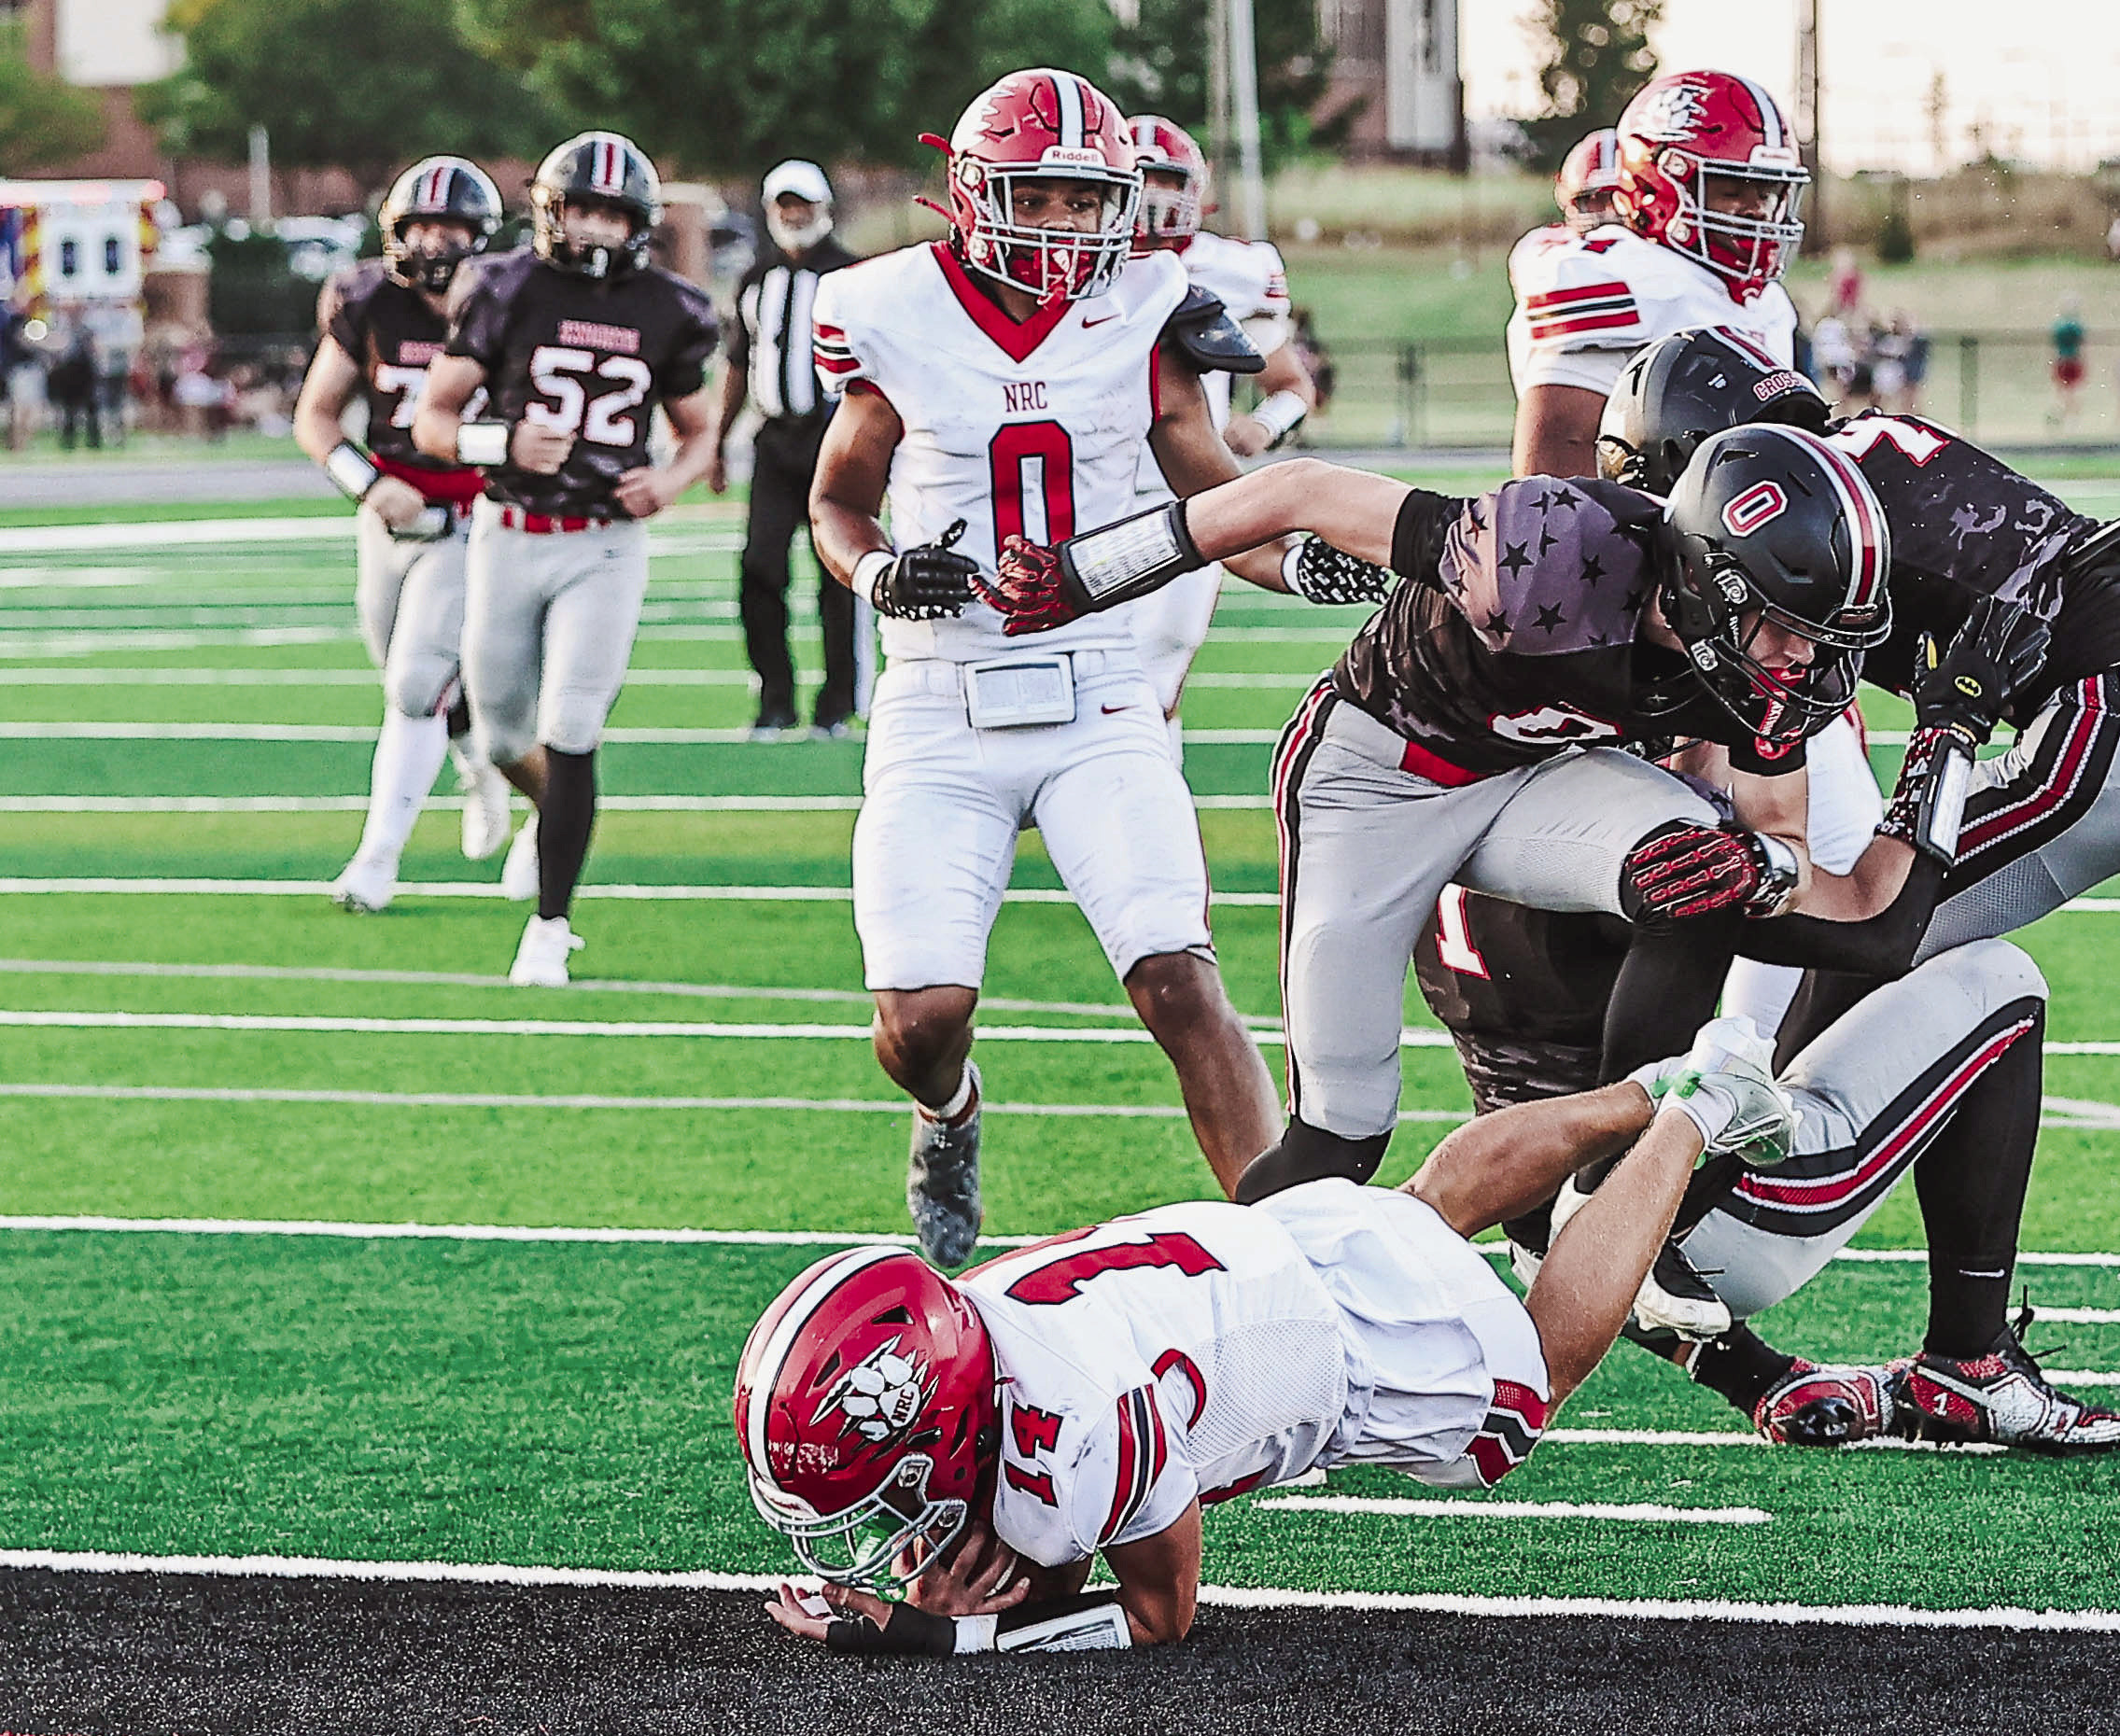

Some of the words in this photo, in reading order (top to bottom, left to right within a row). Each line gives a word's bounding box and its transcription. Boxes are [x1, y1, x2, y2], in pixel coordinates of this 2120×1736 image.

[1051, 149, 1099, 162] Riddell
[524, 343, 652, 447] 52
[1003, 381, 1048, 413] NRC
[988, 418, 1076, 570] 0
[891, 1388, 915, 1424] NRC
[1931, 1391, 1950, 1417] 1
[1003, 1399, 1065, 1509] 14
